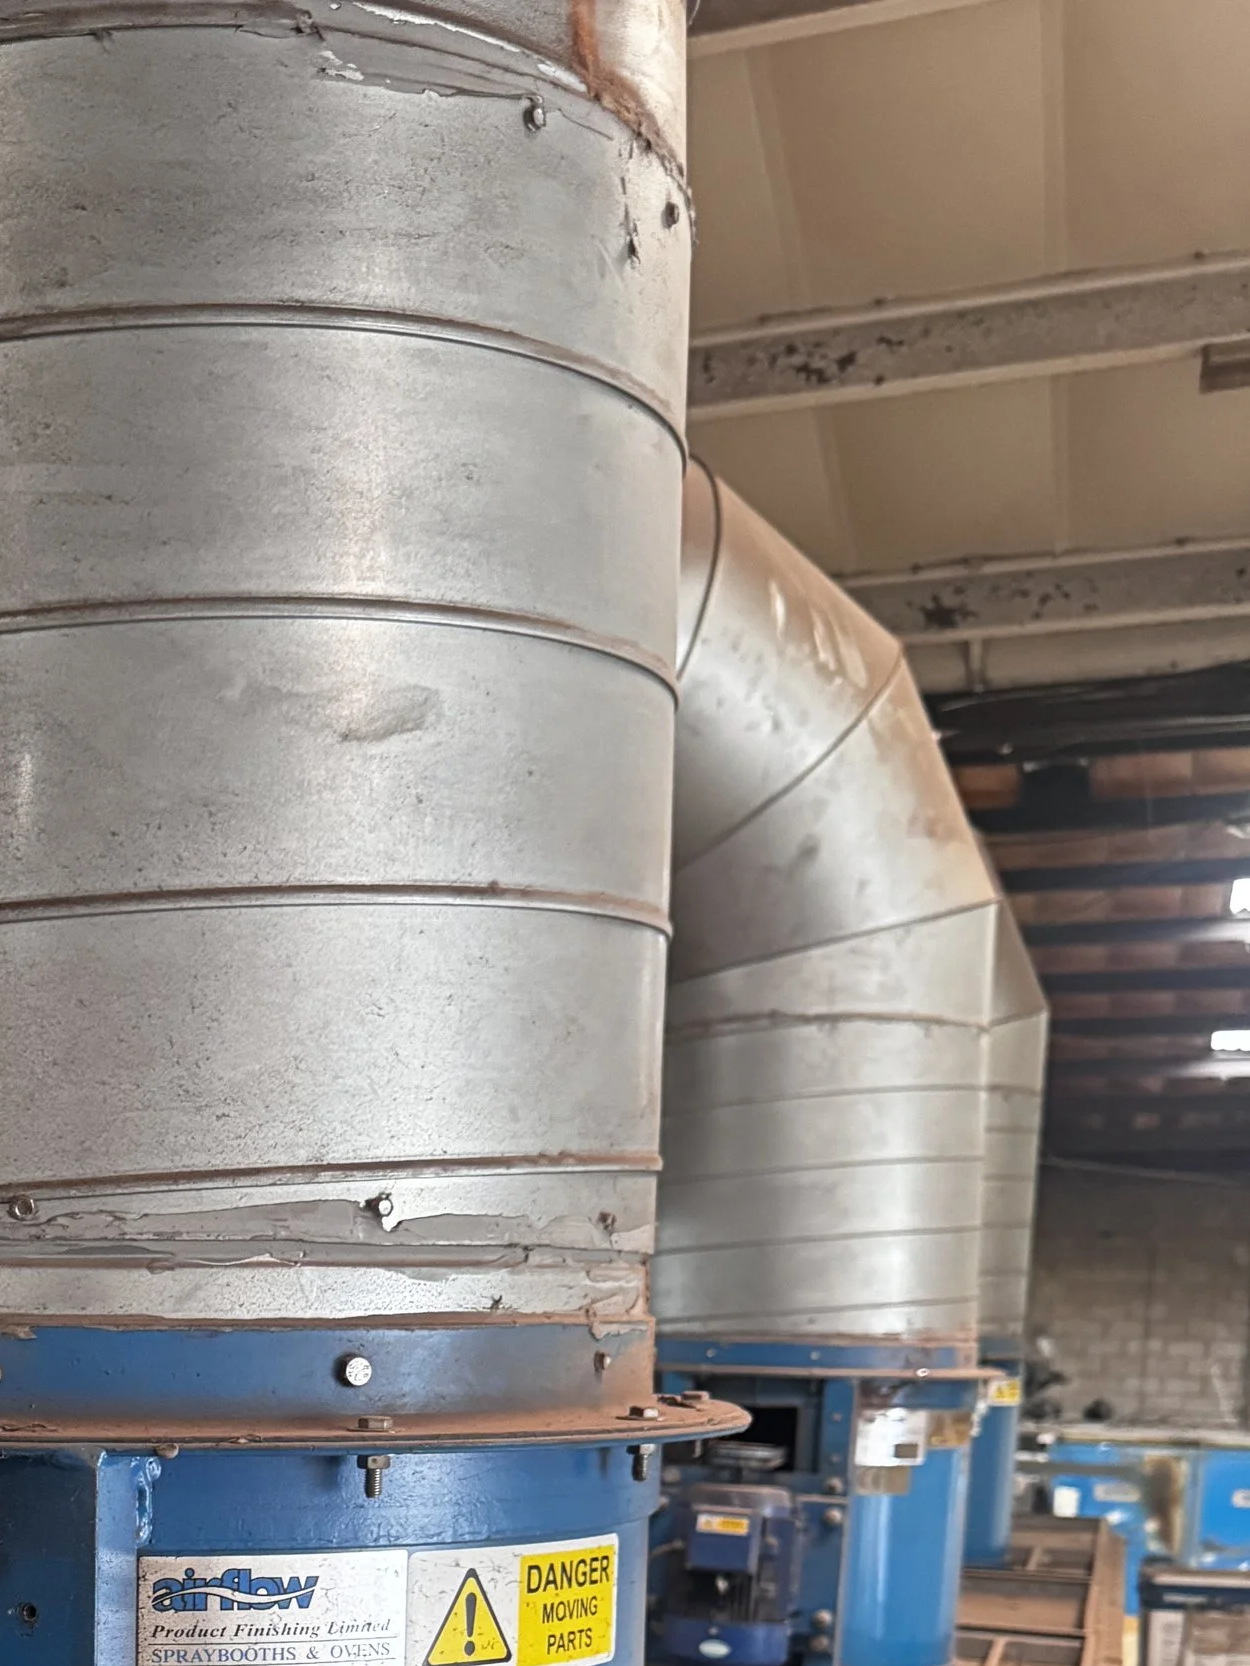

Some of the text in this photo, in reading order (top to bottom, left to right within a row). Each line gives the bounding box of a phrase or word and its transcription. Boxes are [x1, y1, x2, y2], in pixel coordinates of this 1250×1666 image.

[526, 1555, 610, 1594] DANGER
[151, 1568, 320, 1612] airflow
[541, 1596, 598, 1624] MOVING
[150, 1618, 390, 1639] Product Finishing Limited
[546, 1627, 593, 1655] PARTS
[151, 1642, 391, 1664] SPRAYBOOTHS & OVENS
